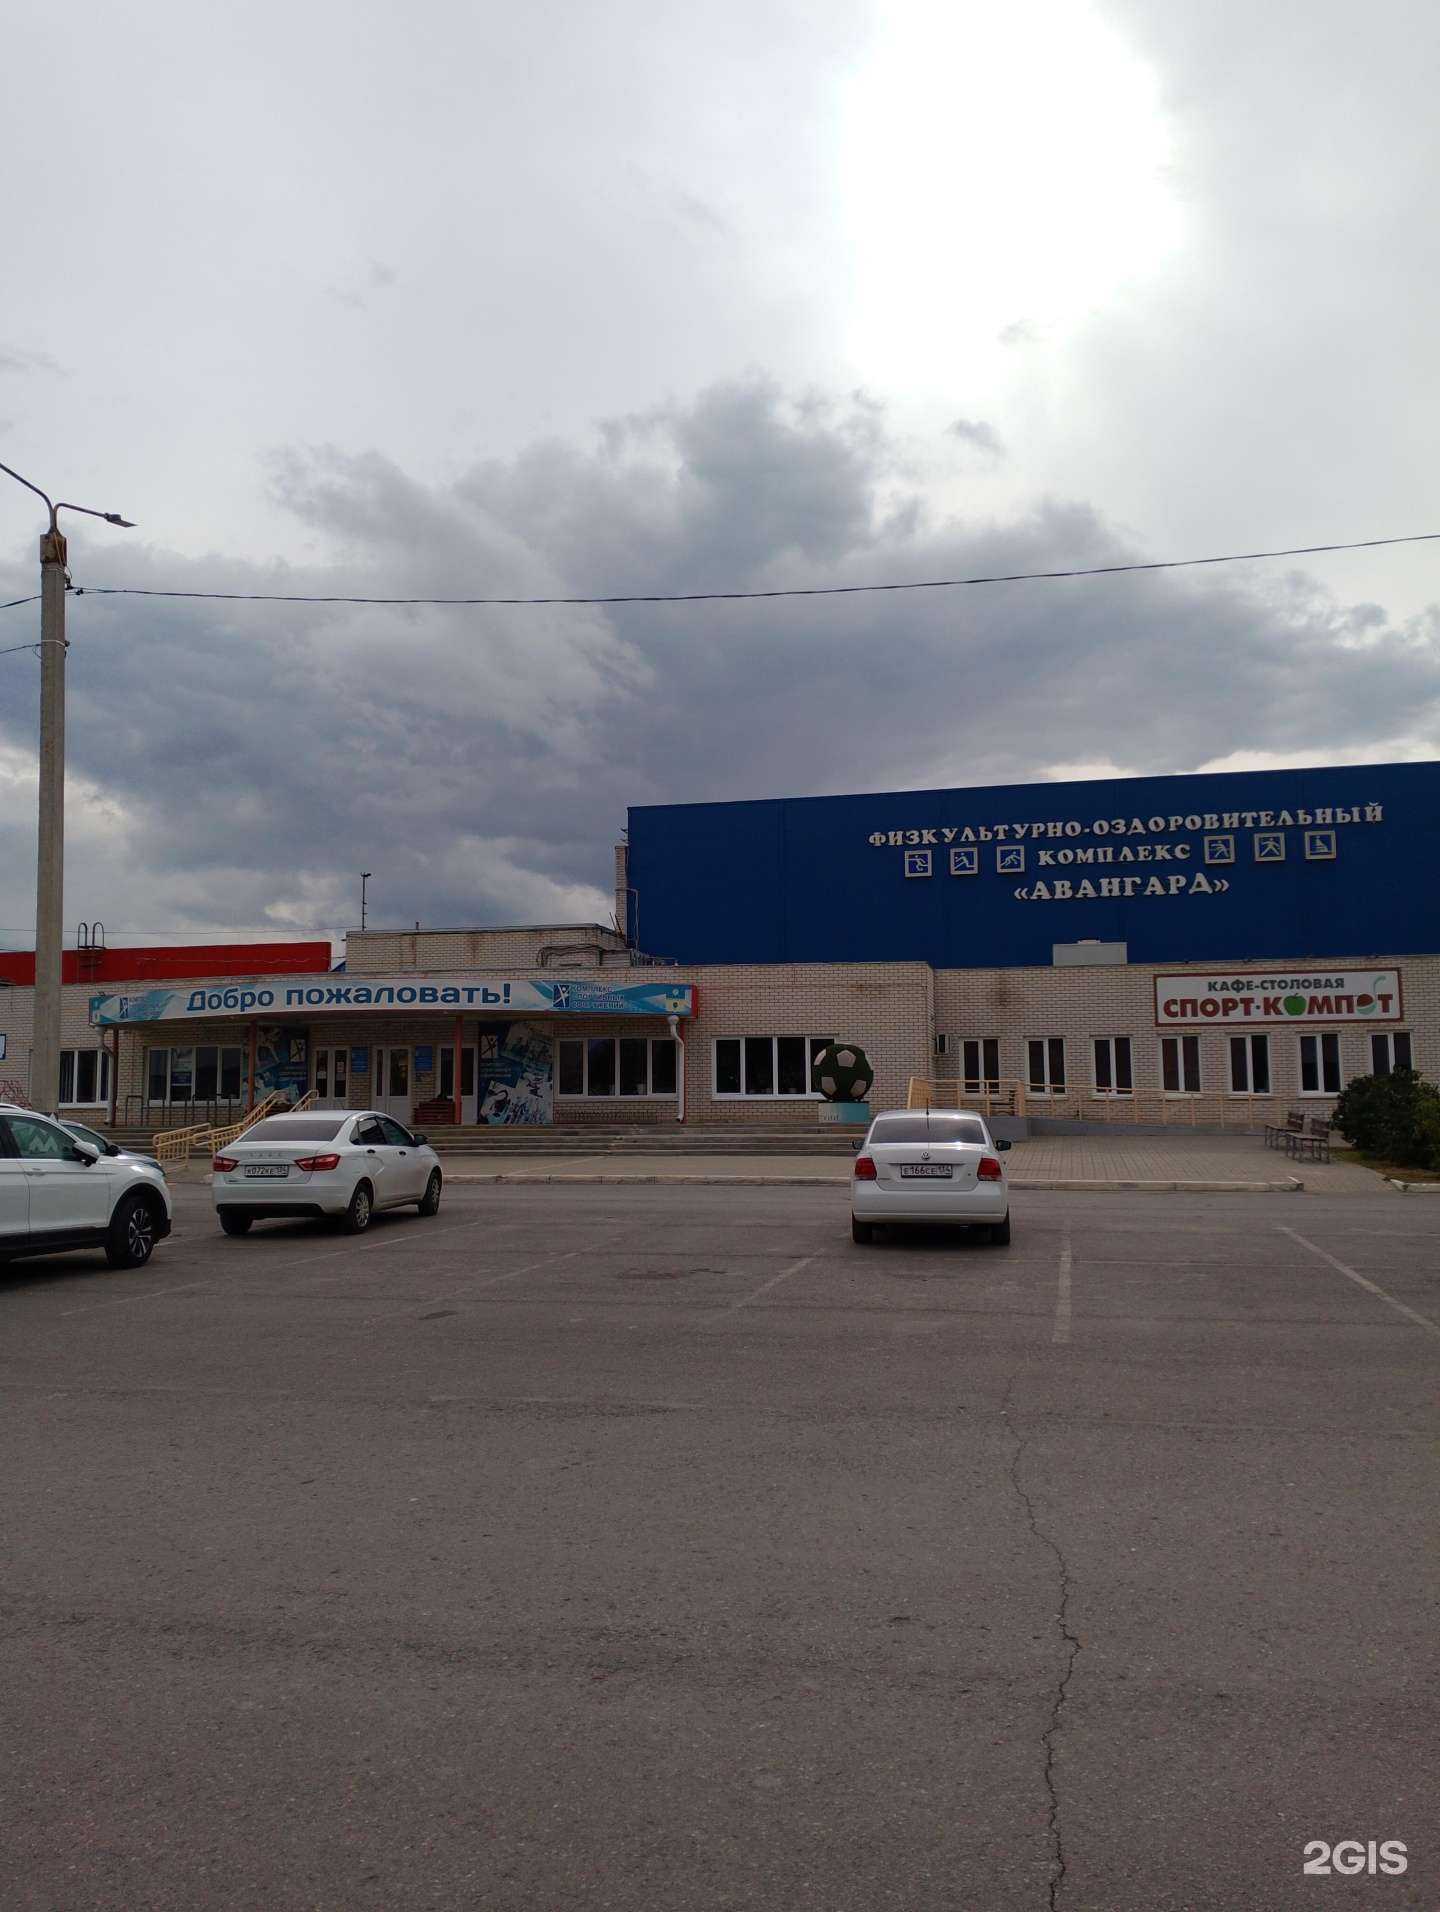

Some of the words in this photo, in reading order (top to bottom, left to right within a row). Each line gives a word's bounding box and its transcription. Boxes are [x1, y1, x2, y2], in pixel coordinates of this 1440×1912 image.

[868, 801, 1384, 847] ФИЗКУЛЬТУРНО-ОЗДОРОВИТЕЛЬНЫЙ
[1037, 844, 1191, 867] КОМПЛЕКС
[1014, 872, 1230, 900] «АВАНГАРД»
[186, 987, 274, 1012] Добро
[287, 983, 511, 1005] пожаловать!
[1207, 977, 1345, 993] КАФЕ-СТОЛОВАЯ
